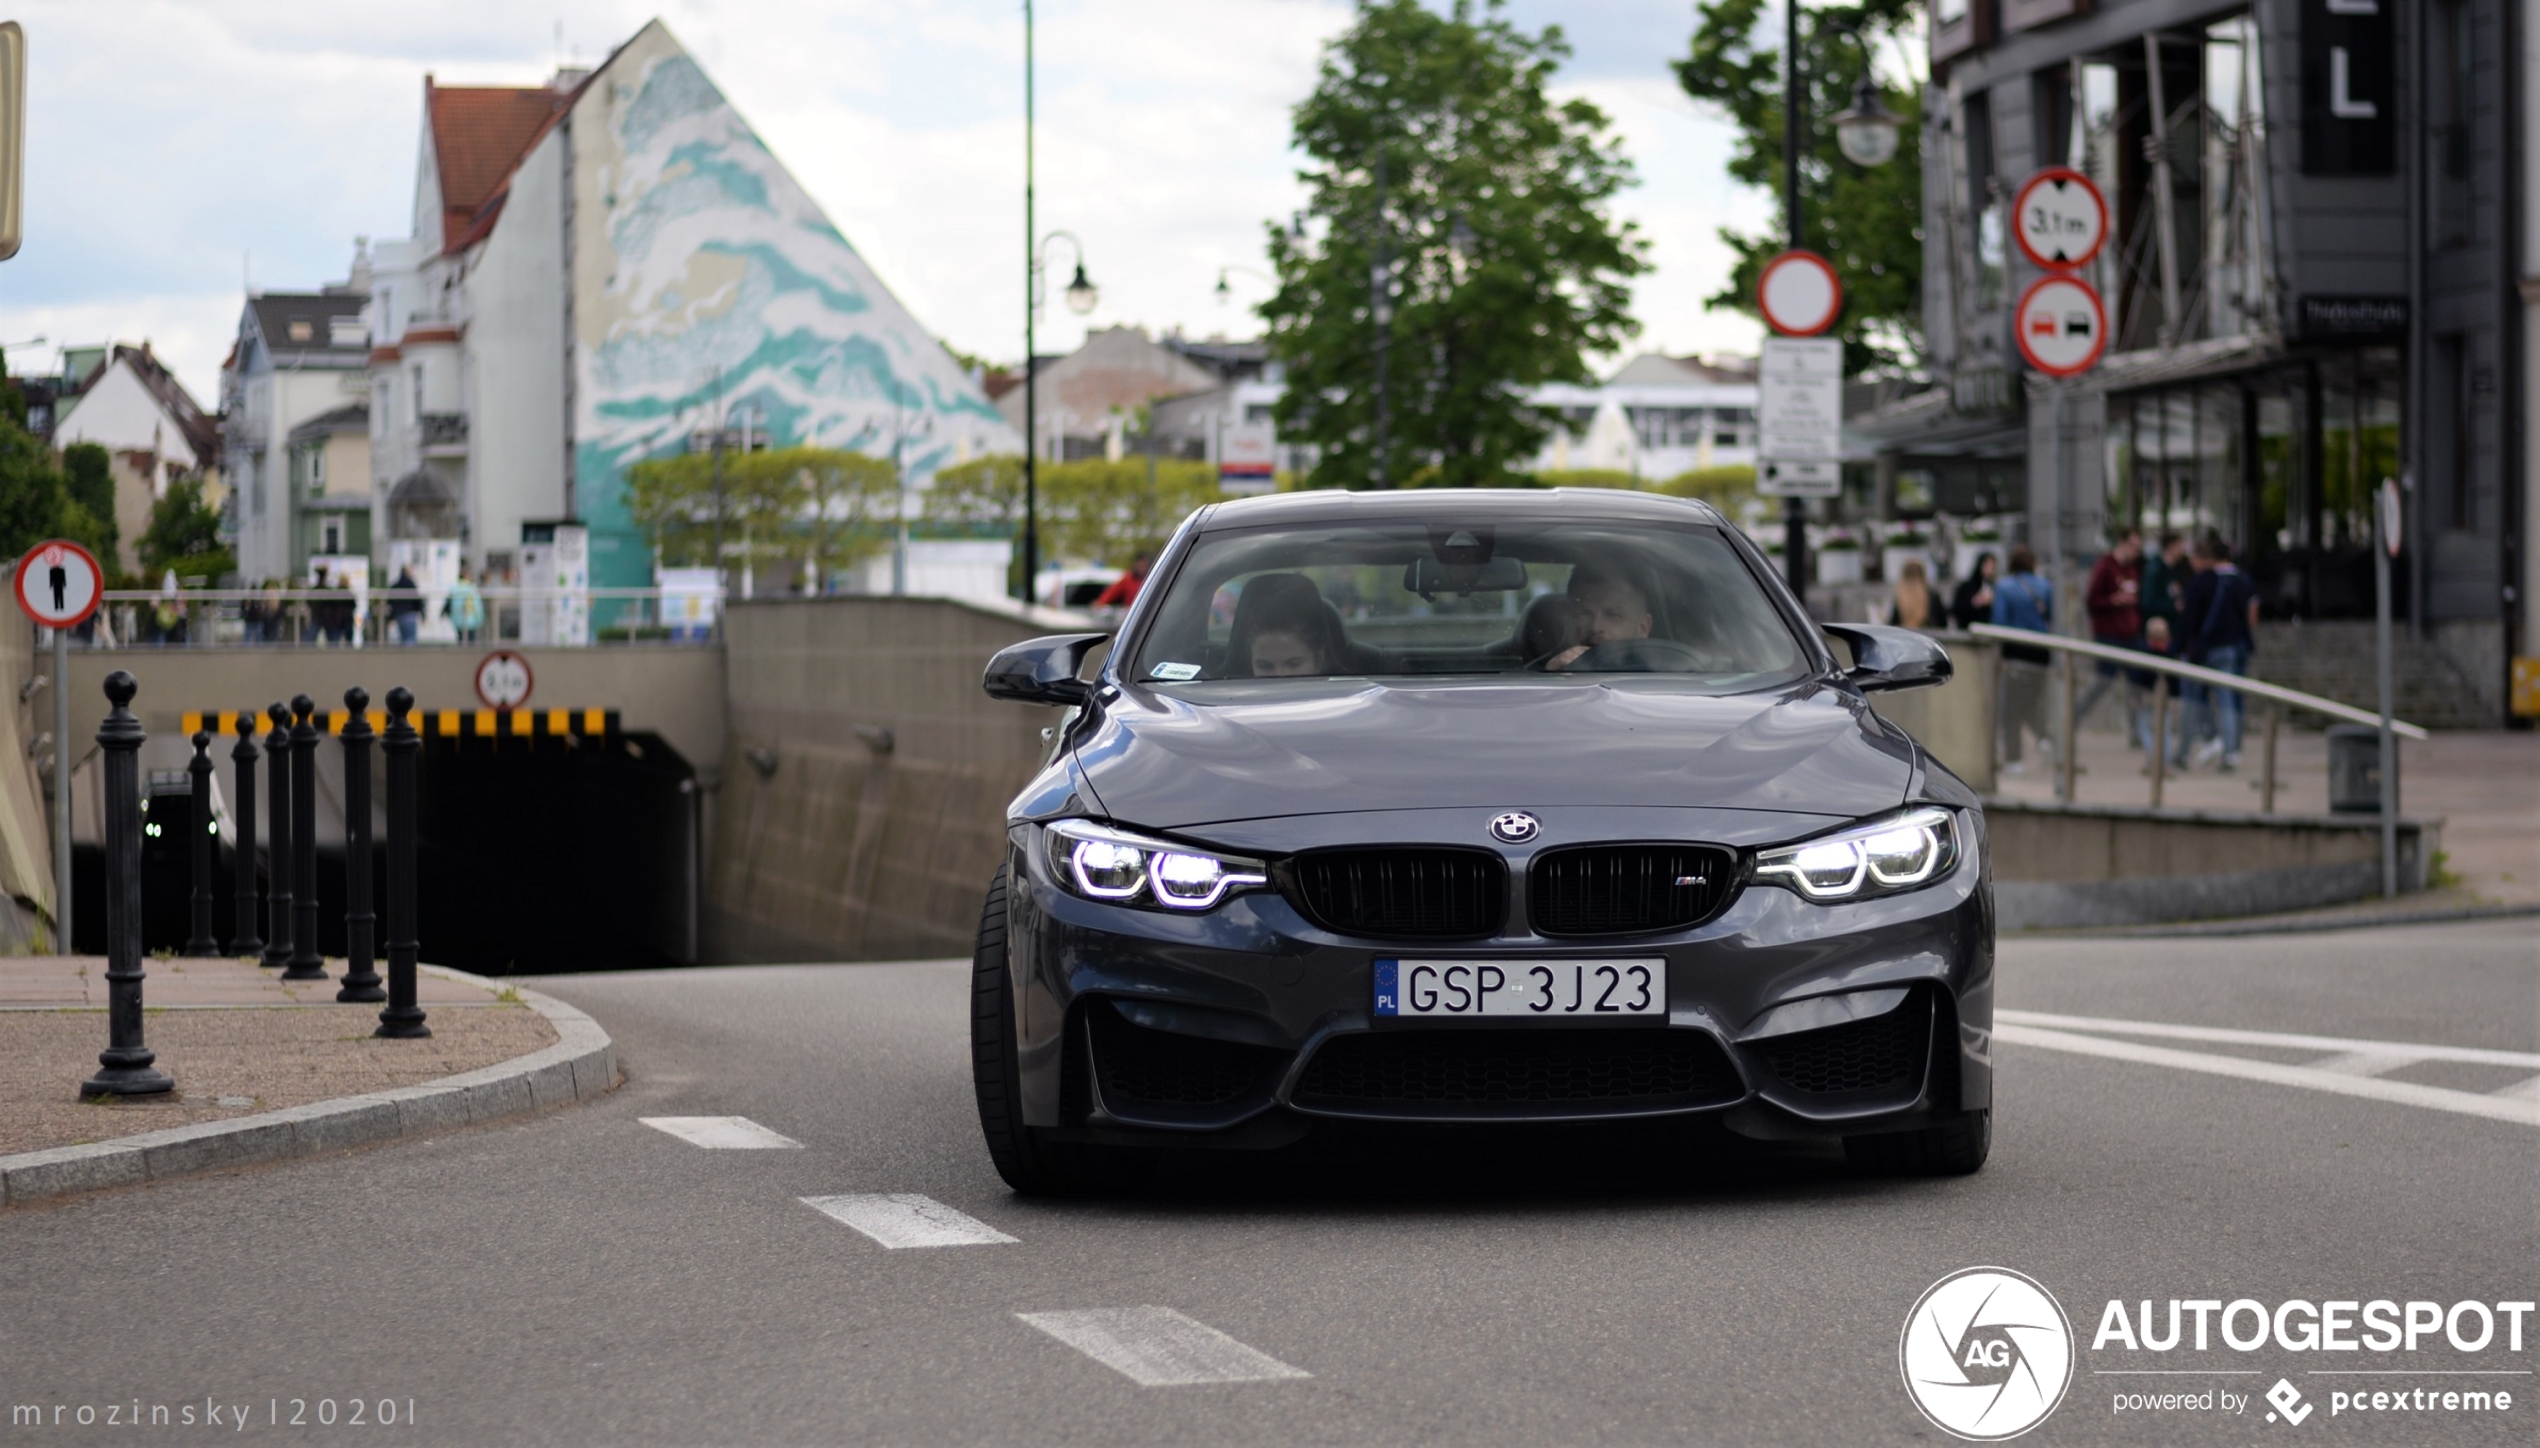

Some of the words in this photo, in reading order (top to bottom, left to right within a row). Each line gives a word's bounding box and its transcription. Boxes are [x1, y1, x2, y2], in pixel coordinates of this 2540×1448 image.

[1378, 995, 1396, 1008] PL
[1409, 965, 1506, 1013] GSP
[1528, 965, 1652, 1013] 3J23
